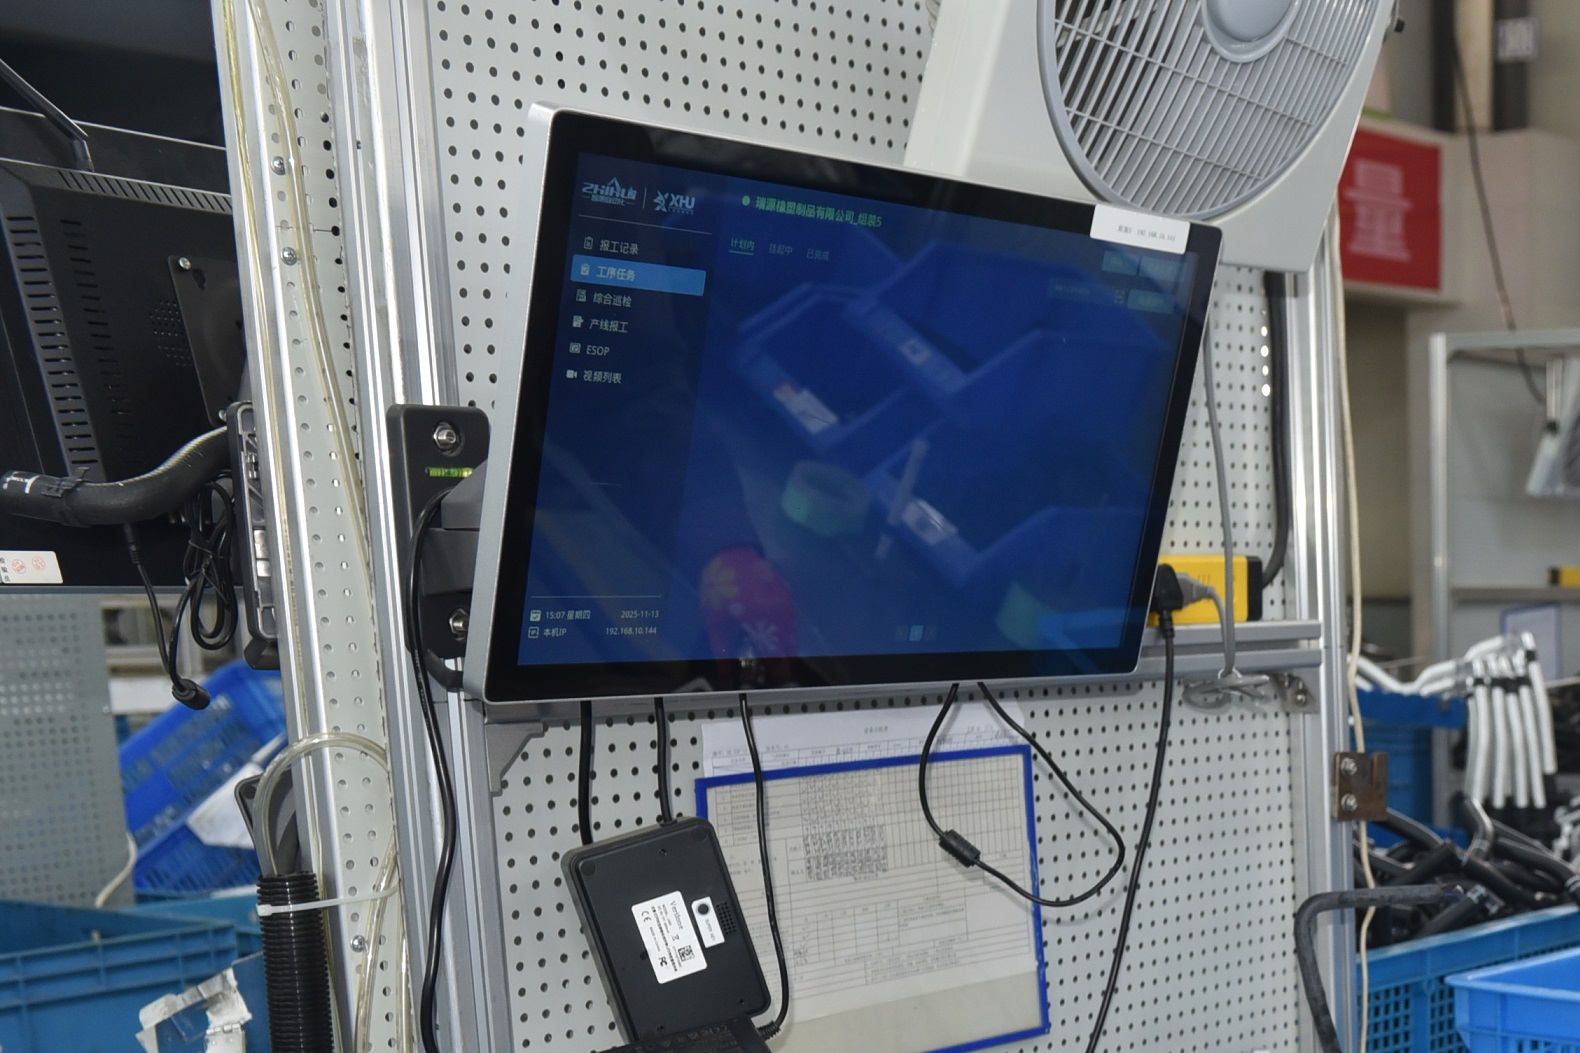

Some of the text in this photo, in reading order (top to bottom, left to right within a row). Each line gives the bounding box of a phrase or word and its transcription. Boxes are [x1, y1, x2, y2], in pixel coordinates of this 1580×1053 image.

[596, 265, 636, 281] 工序任务
[589, 318, 628, 333] 产线报工
[586, 345, 610, 356] ESOP
[583, 370, 622, 384] 视频列表
[545, 610, 565, 620] 15:07
[621, 609, 659, 619] 2025-11-13
[606, 627, 657, 635] 192.168.10.144
